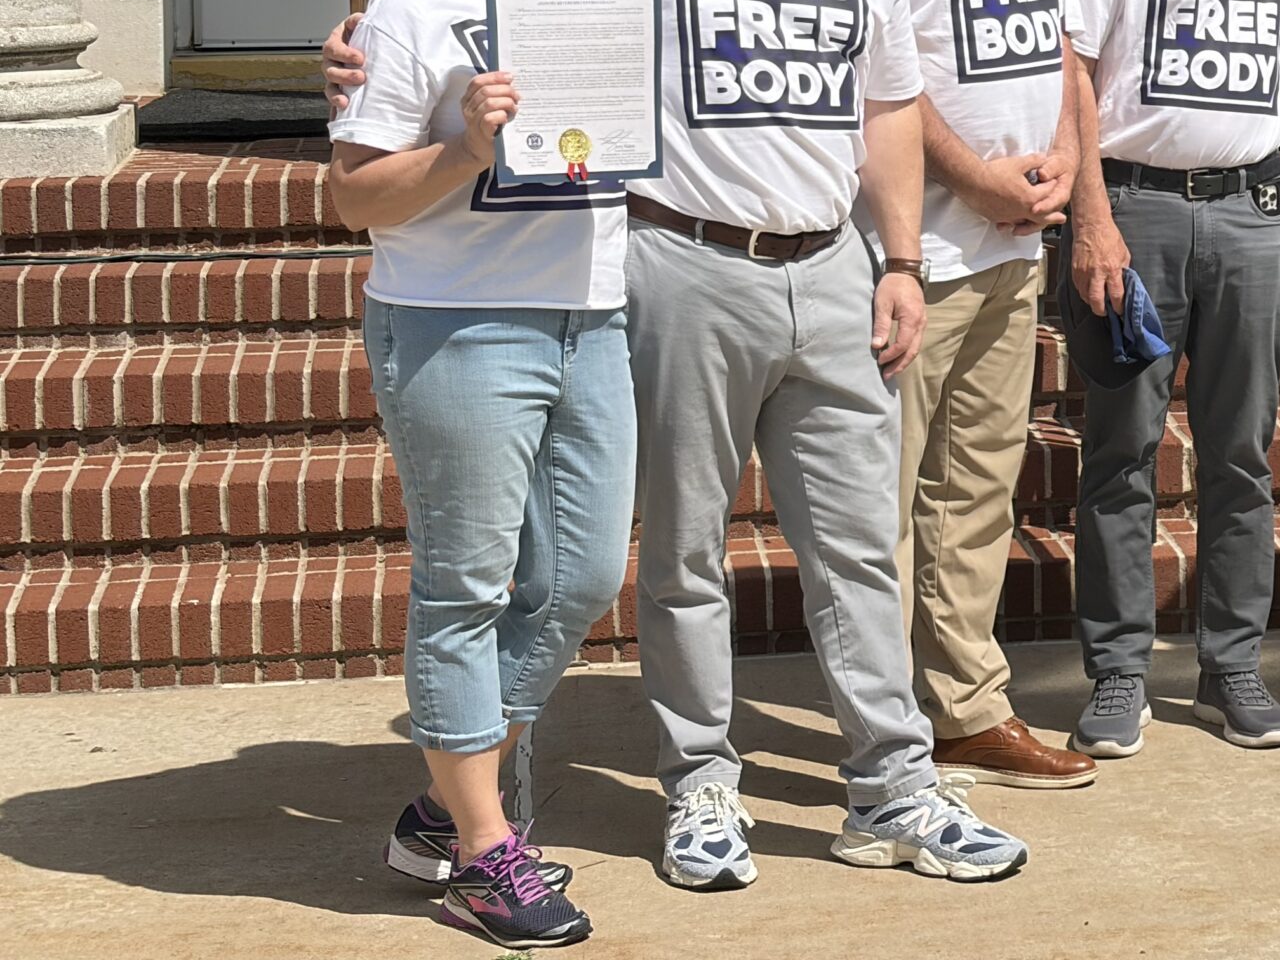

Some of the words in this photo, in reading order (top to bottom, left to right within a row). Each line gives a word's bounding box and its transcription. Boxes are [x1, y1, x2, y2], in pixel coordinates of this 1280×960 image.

[699, 0, 853, 53] FREE
[703, 60, 849, 107] BODY
[1159, 49, 1276, 93] BODY
